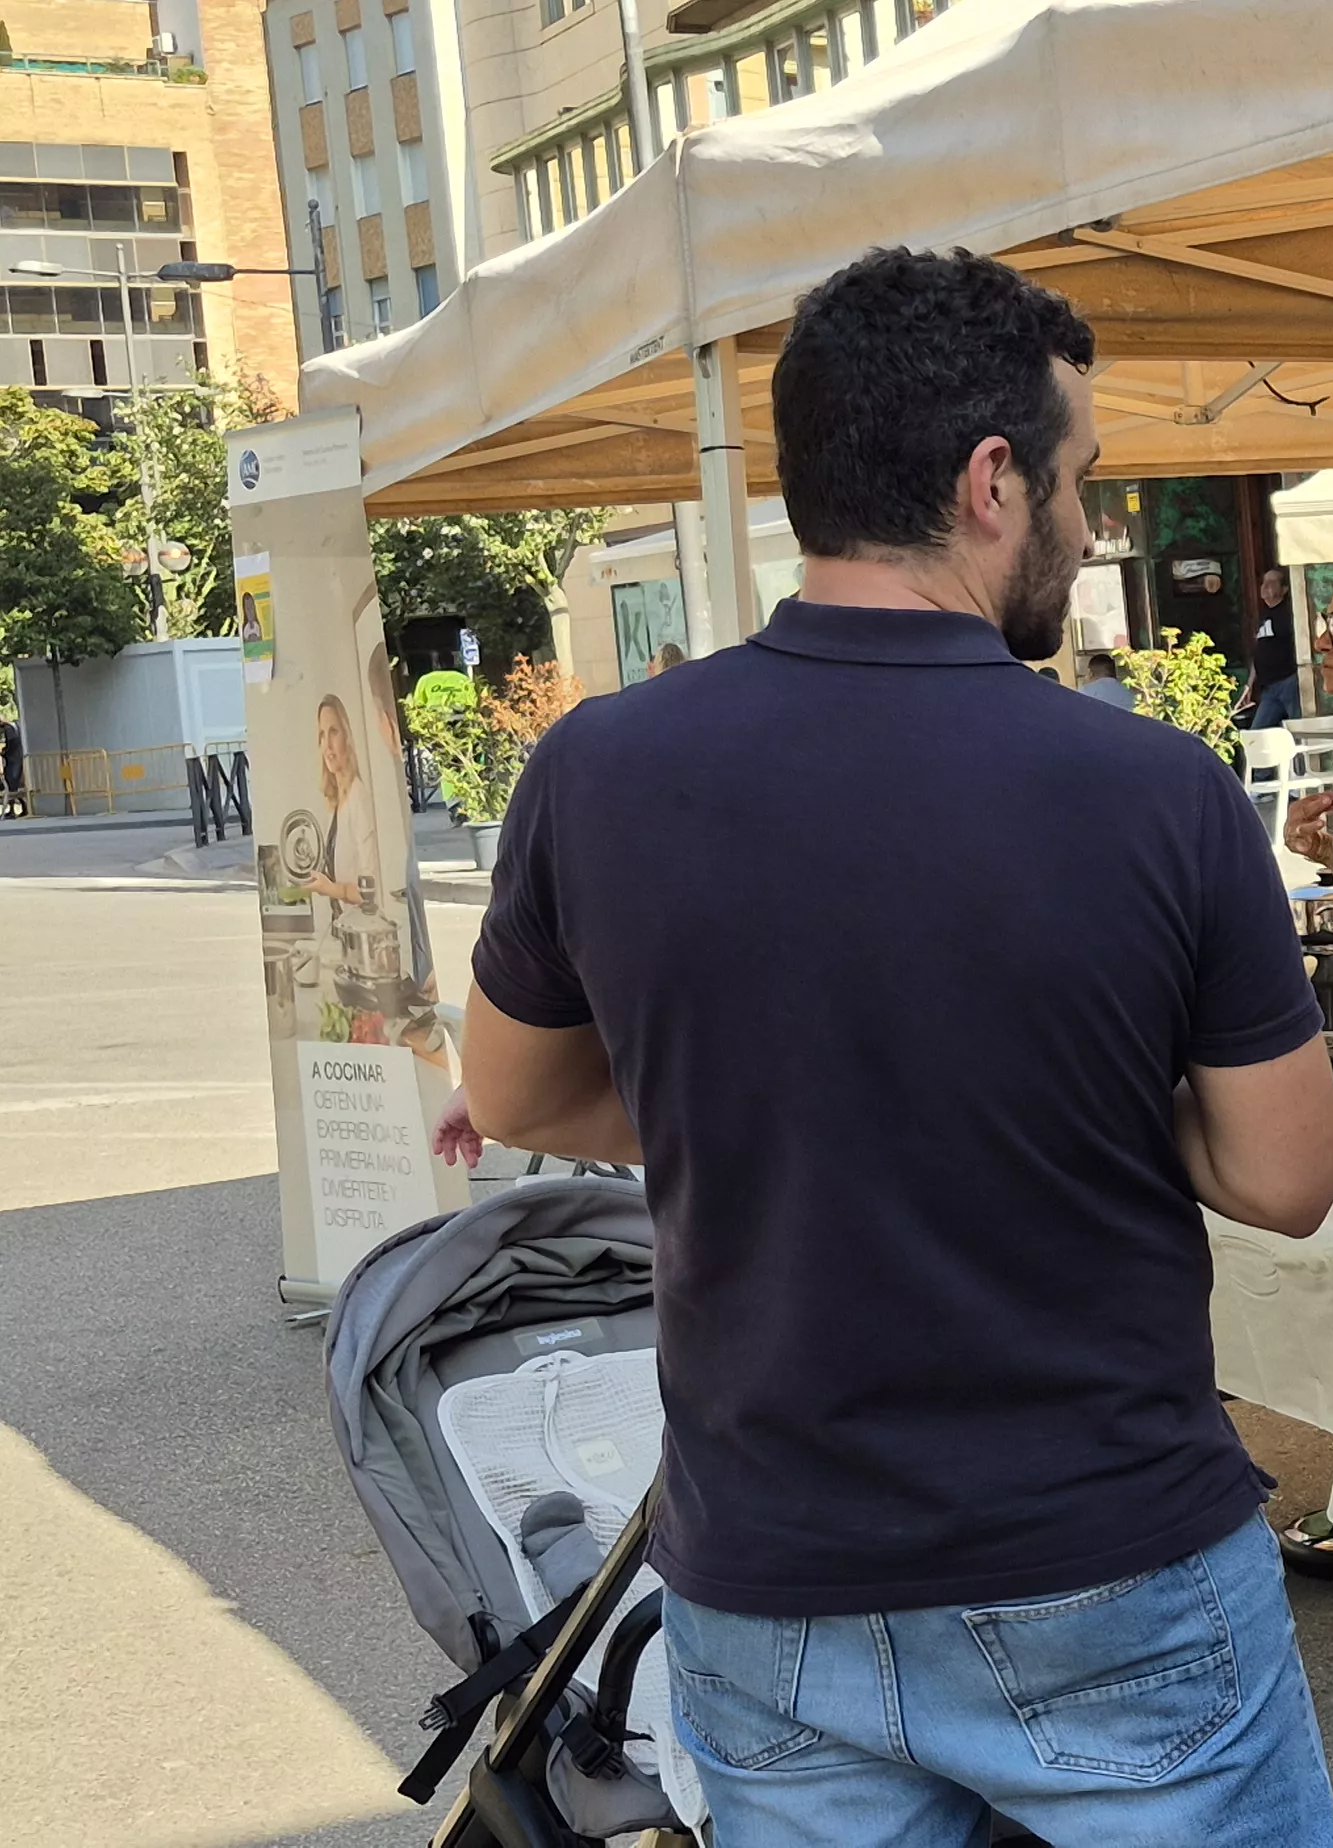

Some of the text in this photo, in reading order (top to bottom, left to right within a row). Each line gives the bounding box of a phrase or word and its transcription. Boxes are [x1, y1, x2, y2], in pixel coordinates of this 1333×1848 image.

[312, 1061, 321, 1080] A
[360, 1092, 386, 1112] UNA
[393, 1126, 410, 1146] DE
[319, 1149, 375, 1171] PRIMERA
